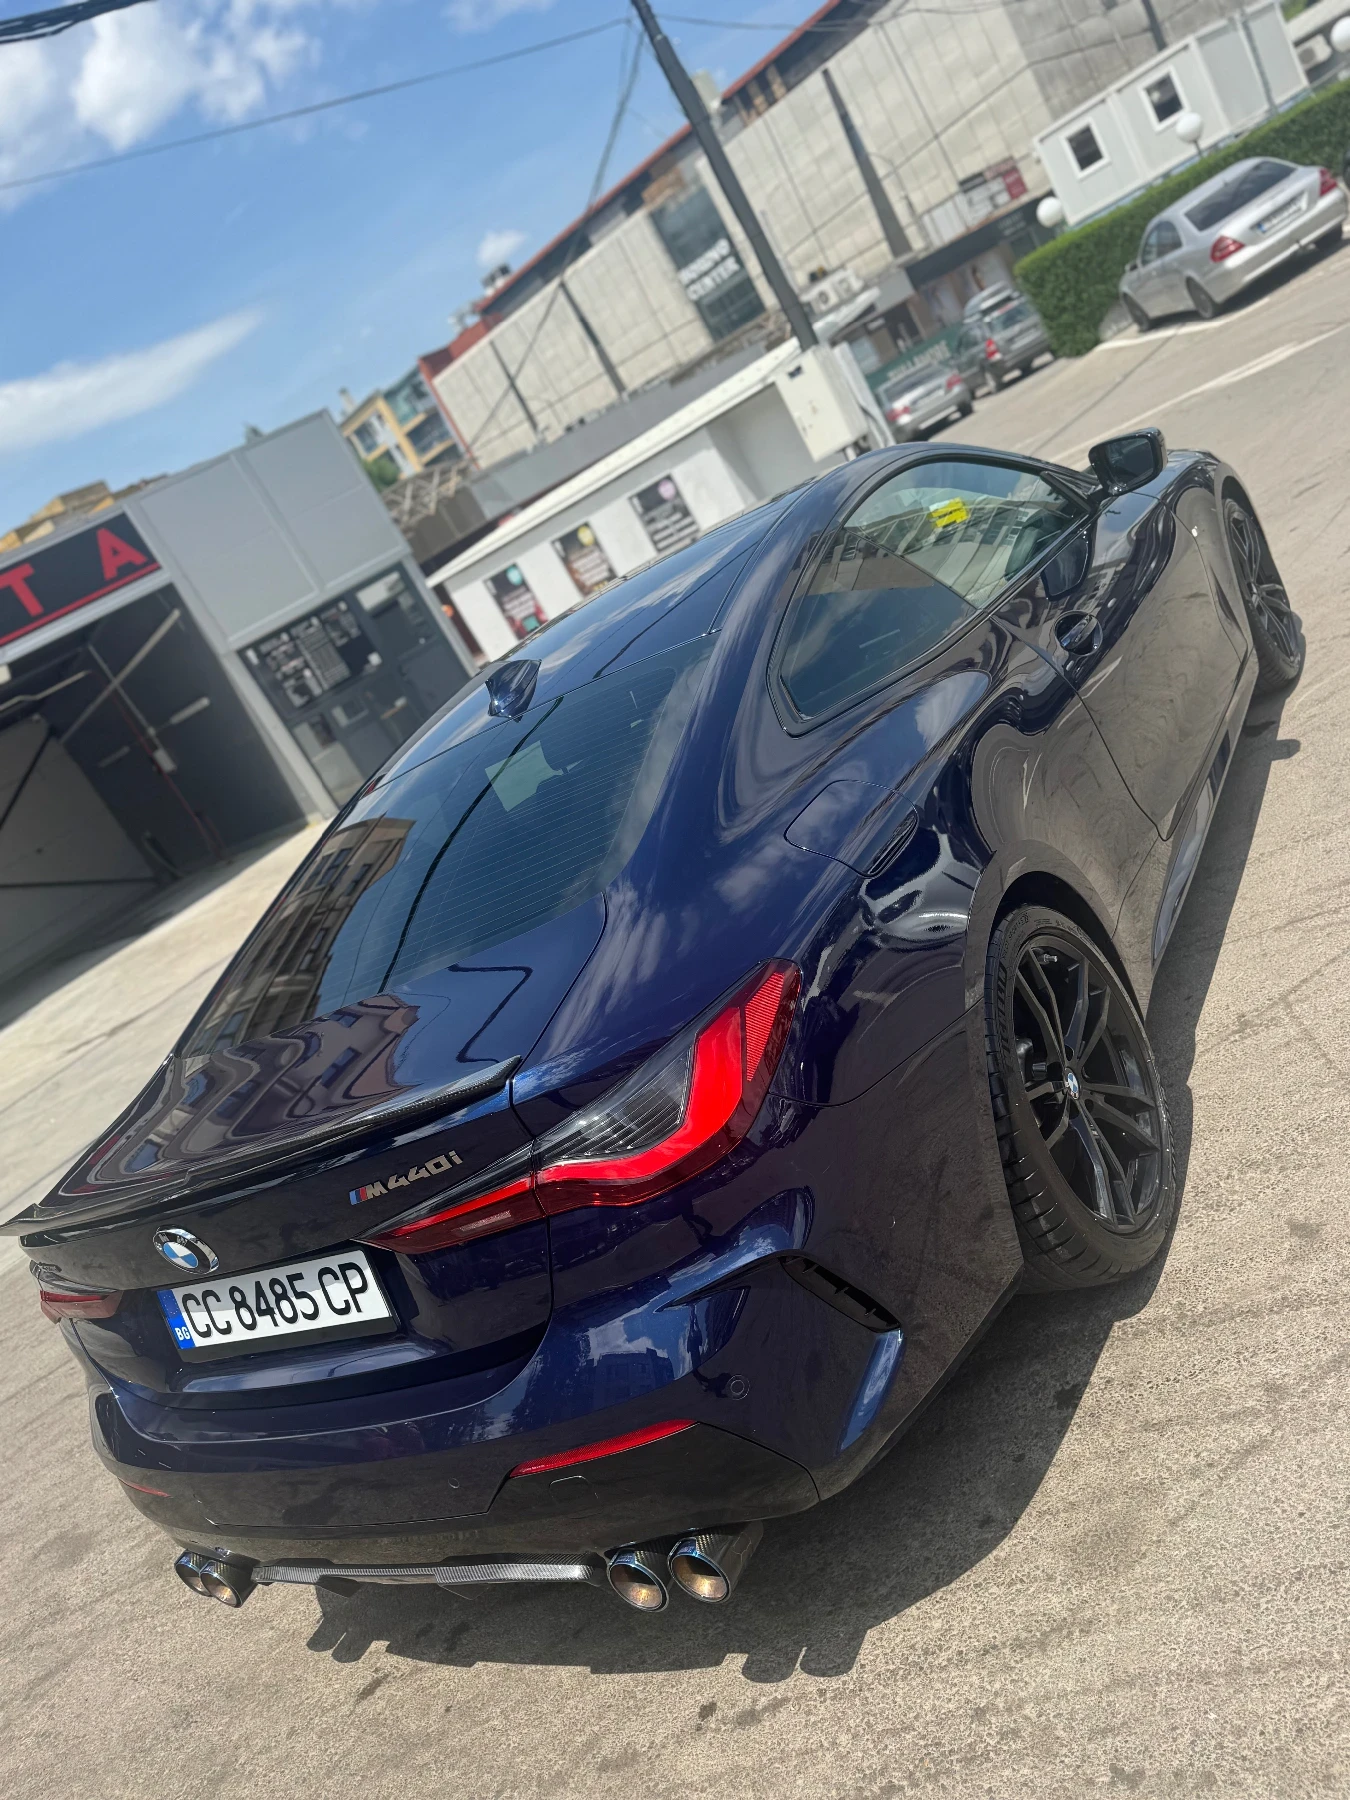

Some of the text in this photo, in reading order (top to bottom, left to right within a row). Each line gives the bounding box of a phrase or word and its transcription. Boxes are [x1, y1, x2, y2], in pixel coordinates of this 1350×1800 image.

[364, 1150, 463, 1201] M440i
[181, 1261, 368, 1339] CC 8485 CP
[174, 1327, 191, 1341] BG
